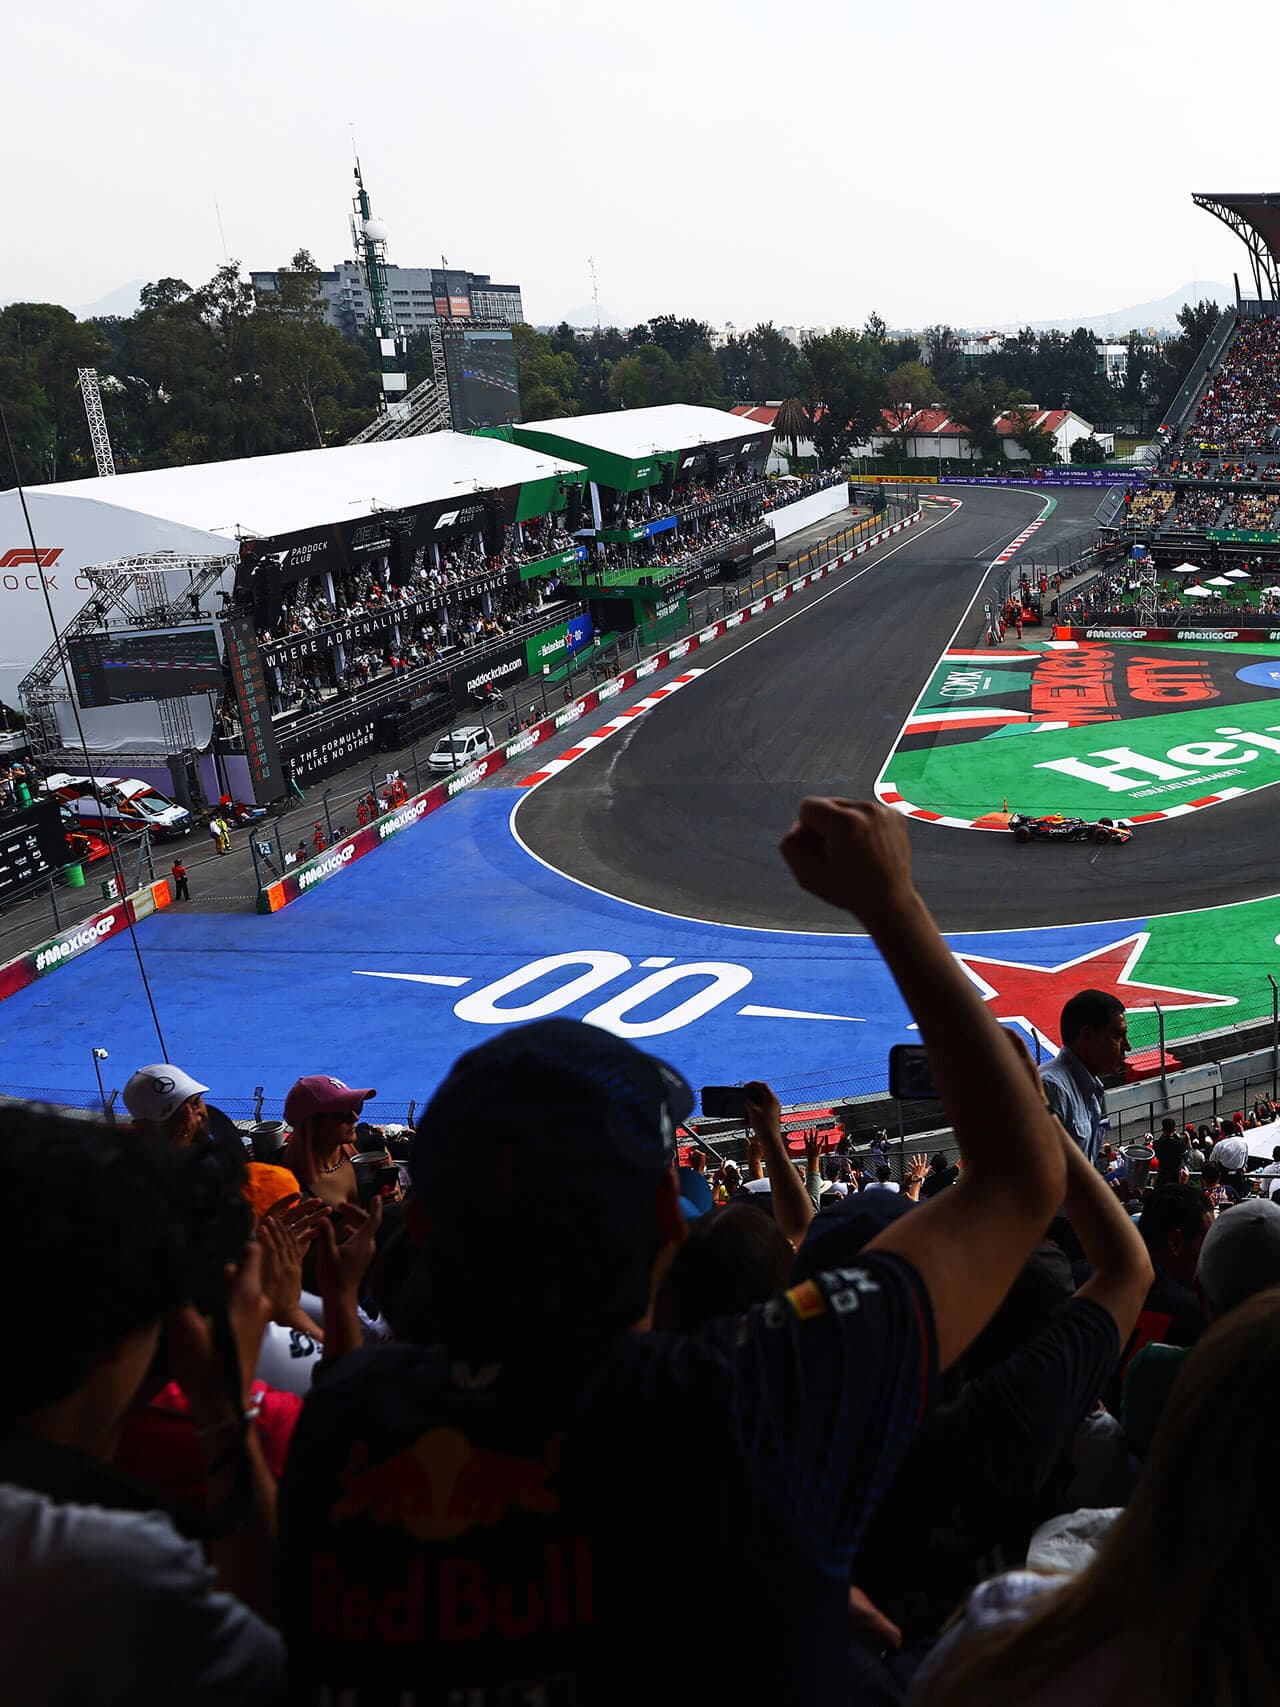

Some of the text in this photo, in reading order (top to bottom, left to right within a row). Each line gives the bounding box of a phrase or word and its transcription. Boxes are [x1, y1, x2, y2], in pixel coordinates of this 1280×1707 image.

[290, 554, 312, 566] CLUB
[291, 541, 329, 555] PADDOCK
[3, 575, 59, 590] OCK
[266, 576, 508, 668] WHERE ADRENALINE MEETS ELEGANCE
[1086, 630, 1147, 639] #MexicoGP
[1177, 631, 1238, 640] #MexicoGP
[466, 658, 522, 693] paddockclub.com
[939, 671, 984, 697] CDMX
[1031, 648, 1122, 722] MEXICO
[1127, 656, 1220, 703] CITY
[555, 702, 586, 728] #MexicoGP
[299, 749, 318, 764] THE
[321, 731, 362, 754] FORMULA
[307, 756, 329, 776] LIKE
[332, 747, 344, 760] NO
[347, 732, 375, 752] OTHER
[506, 730, 541, 758] #MexicoGP
[447, 761, 489, 795] #MexicoGP
[379, 799, 428, 838] #MexicoGP
[298, 844, 355, 889] #MexicoGP
[35, 914, 116, 970] #MexicoGP
[311, 1536, 598, 1645] Red Bull
